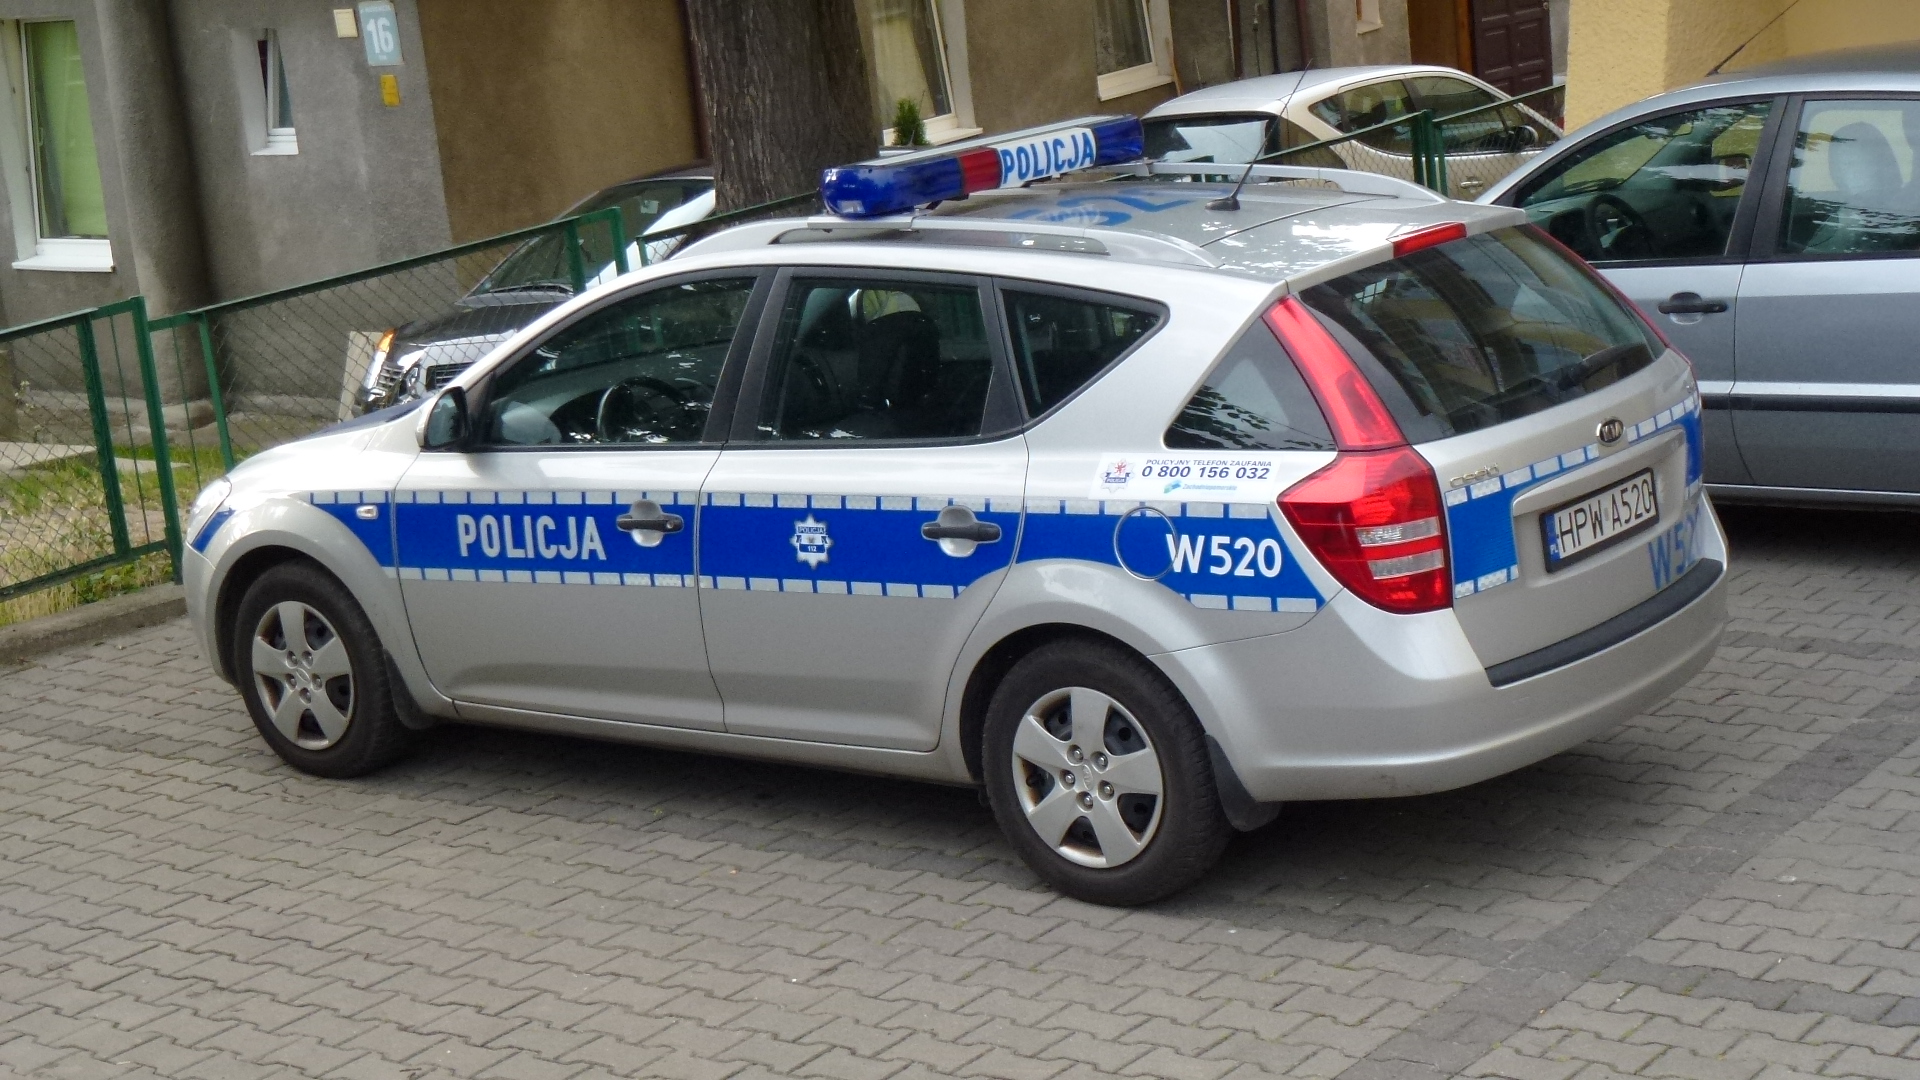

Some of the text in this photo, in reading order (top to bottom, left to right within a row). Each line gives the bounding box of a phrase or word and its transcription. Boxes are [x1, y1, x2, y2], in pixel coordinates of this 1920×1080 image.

[366, 17, 394, 53] 16
[1000, 132, 1095, 185] POLICJA
[1141, 465, 1270, 480] 0 800 156 032
[457, 514, 607, 561] POLICJA
[798, 526, 825, 534] POLICJA
[1558, 479, 1653, 553] HPW A520
[1165, 533, 1283, 578] W520
